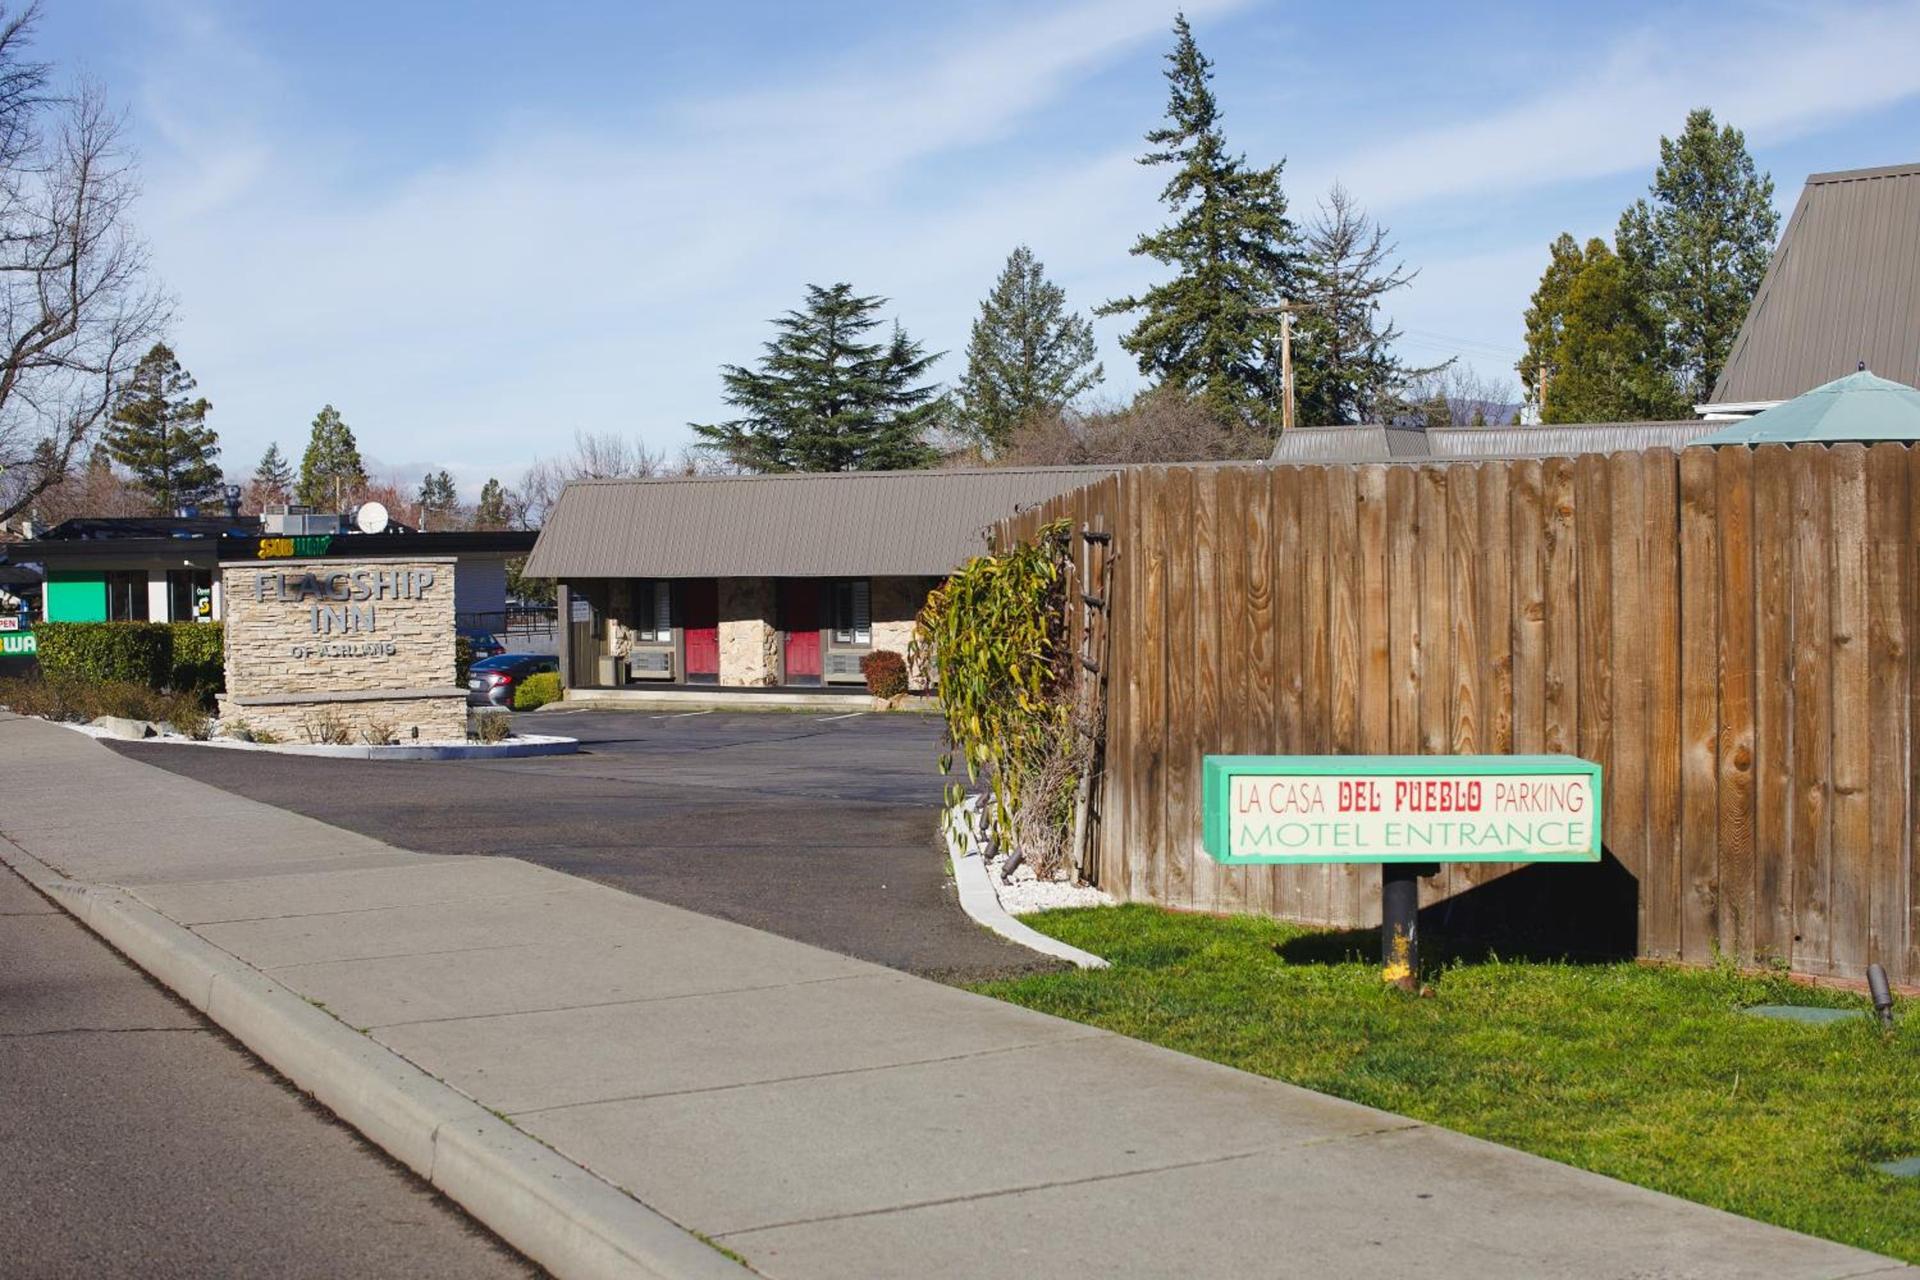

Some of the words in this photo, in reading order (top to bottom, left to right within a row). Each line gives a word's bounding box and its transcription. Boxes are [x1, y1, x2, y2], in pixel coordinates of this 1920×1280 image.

[255, 570, 434, 603] FLAGSHIP
[310, 605, 376, 635] INN
[0, 636, 37, 652] WA
[290, 645, 316, 659] OF
[1238, 783, 1262, 813] LA
[1269, 783, 1325, 814] CASA
[1338, 781, 1381, 812] DEL
[1395, 781, 1482, 812] PUEBLO
[1495, 782, 1583, 813] PARKING
[1240, 822, 1368, 847] MOTEL
[1384, 821, 1583, 847] ENTRANCE
